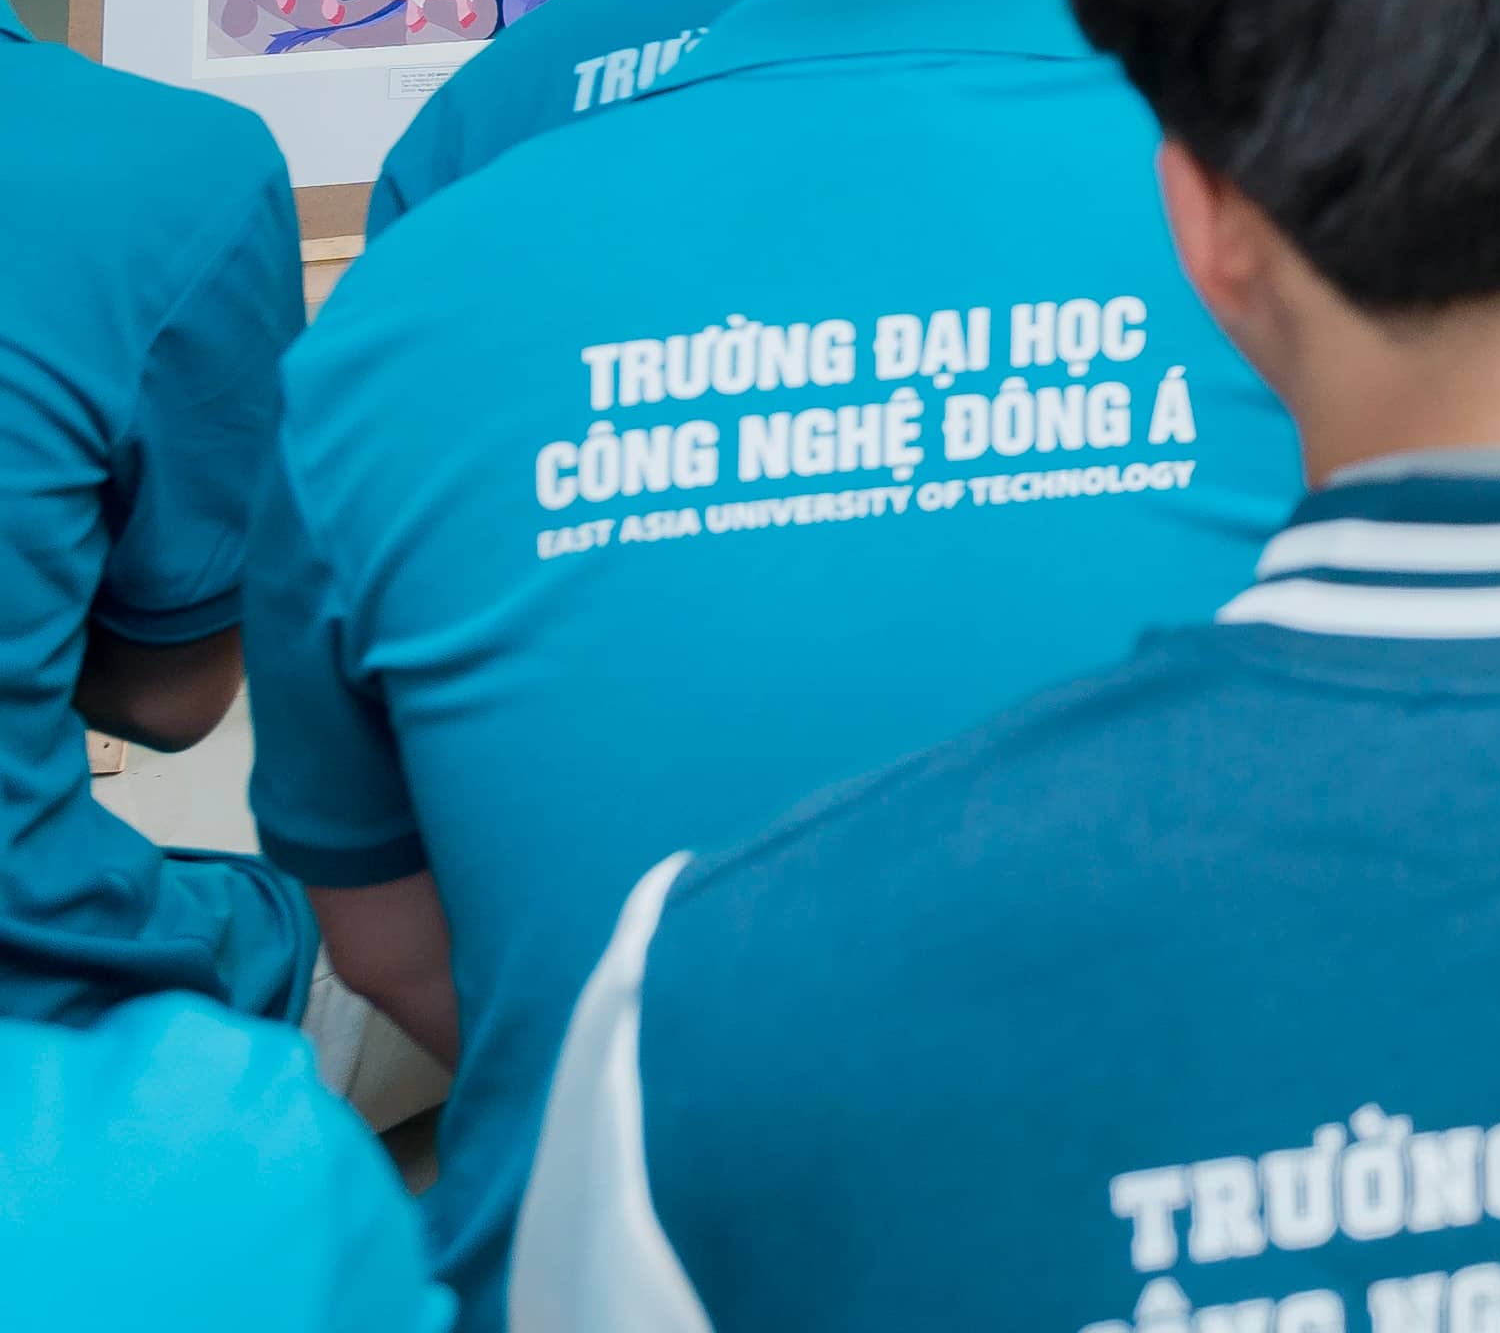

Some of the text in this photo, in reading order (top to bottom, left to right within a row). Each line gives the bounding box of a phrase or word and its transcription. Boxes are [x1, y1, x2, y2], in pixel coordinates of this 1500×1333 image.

[581, 295, 1147, 411] TRƯỜNG ĐẠI HỌC
[535, 365, 1197, 511] CÔNG NGHỆ ĐÔNG Á
[536, 460, 1197, 560] EAST ASIA UNIVERSITY OF TECHNOLOGY
